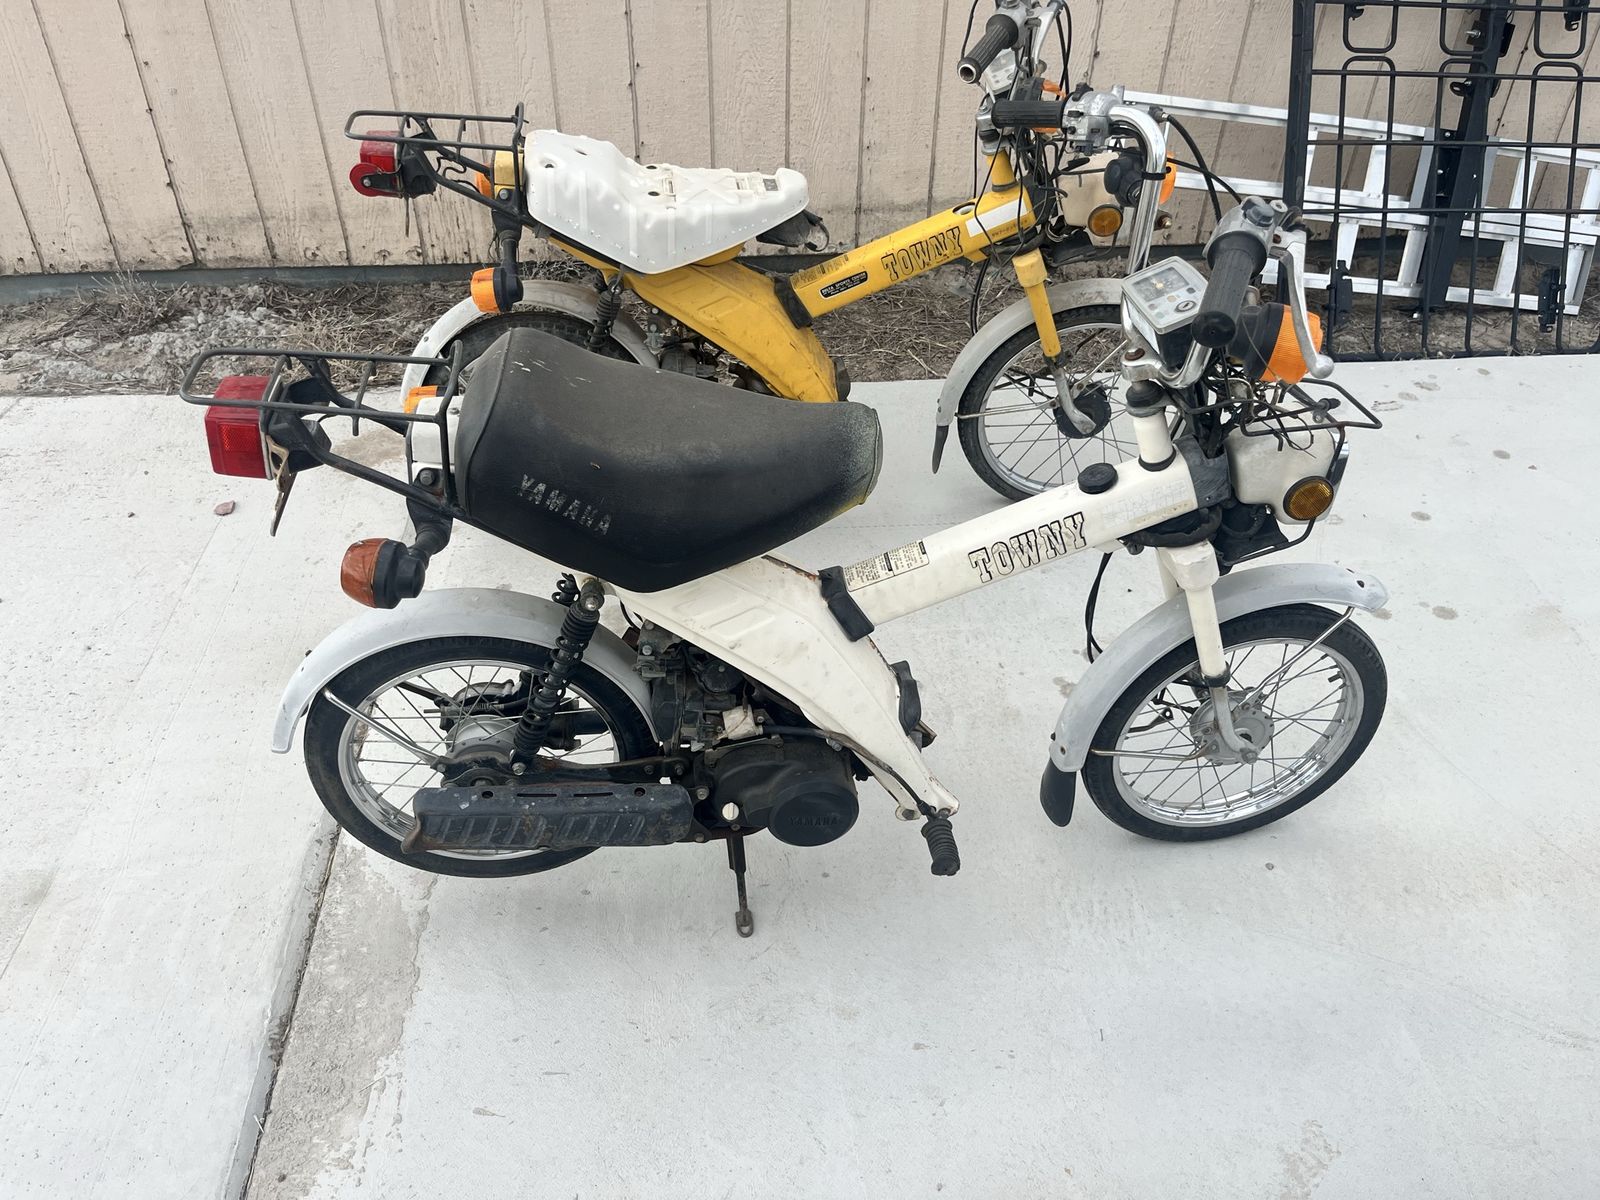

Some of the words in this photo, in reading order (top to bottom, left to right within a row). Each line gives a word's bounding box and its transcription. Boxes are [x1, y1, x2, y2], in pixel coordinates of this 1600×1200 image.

[881, 226, 964, 281] TOWNY
[518, 473, 611, 535] YAMAHA
[968, 511, 1087, 583] TOWNY
